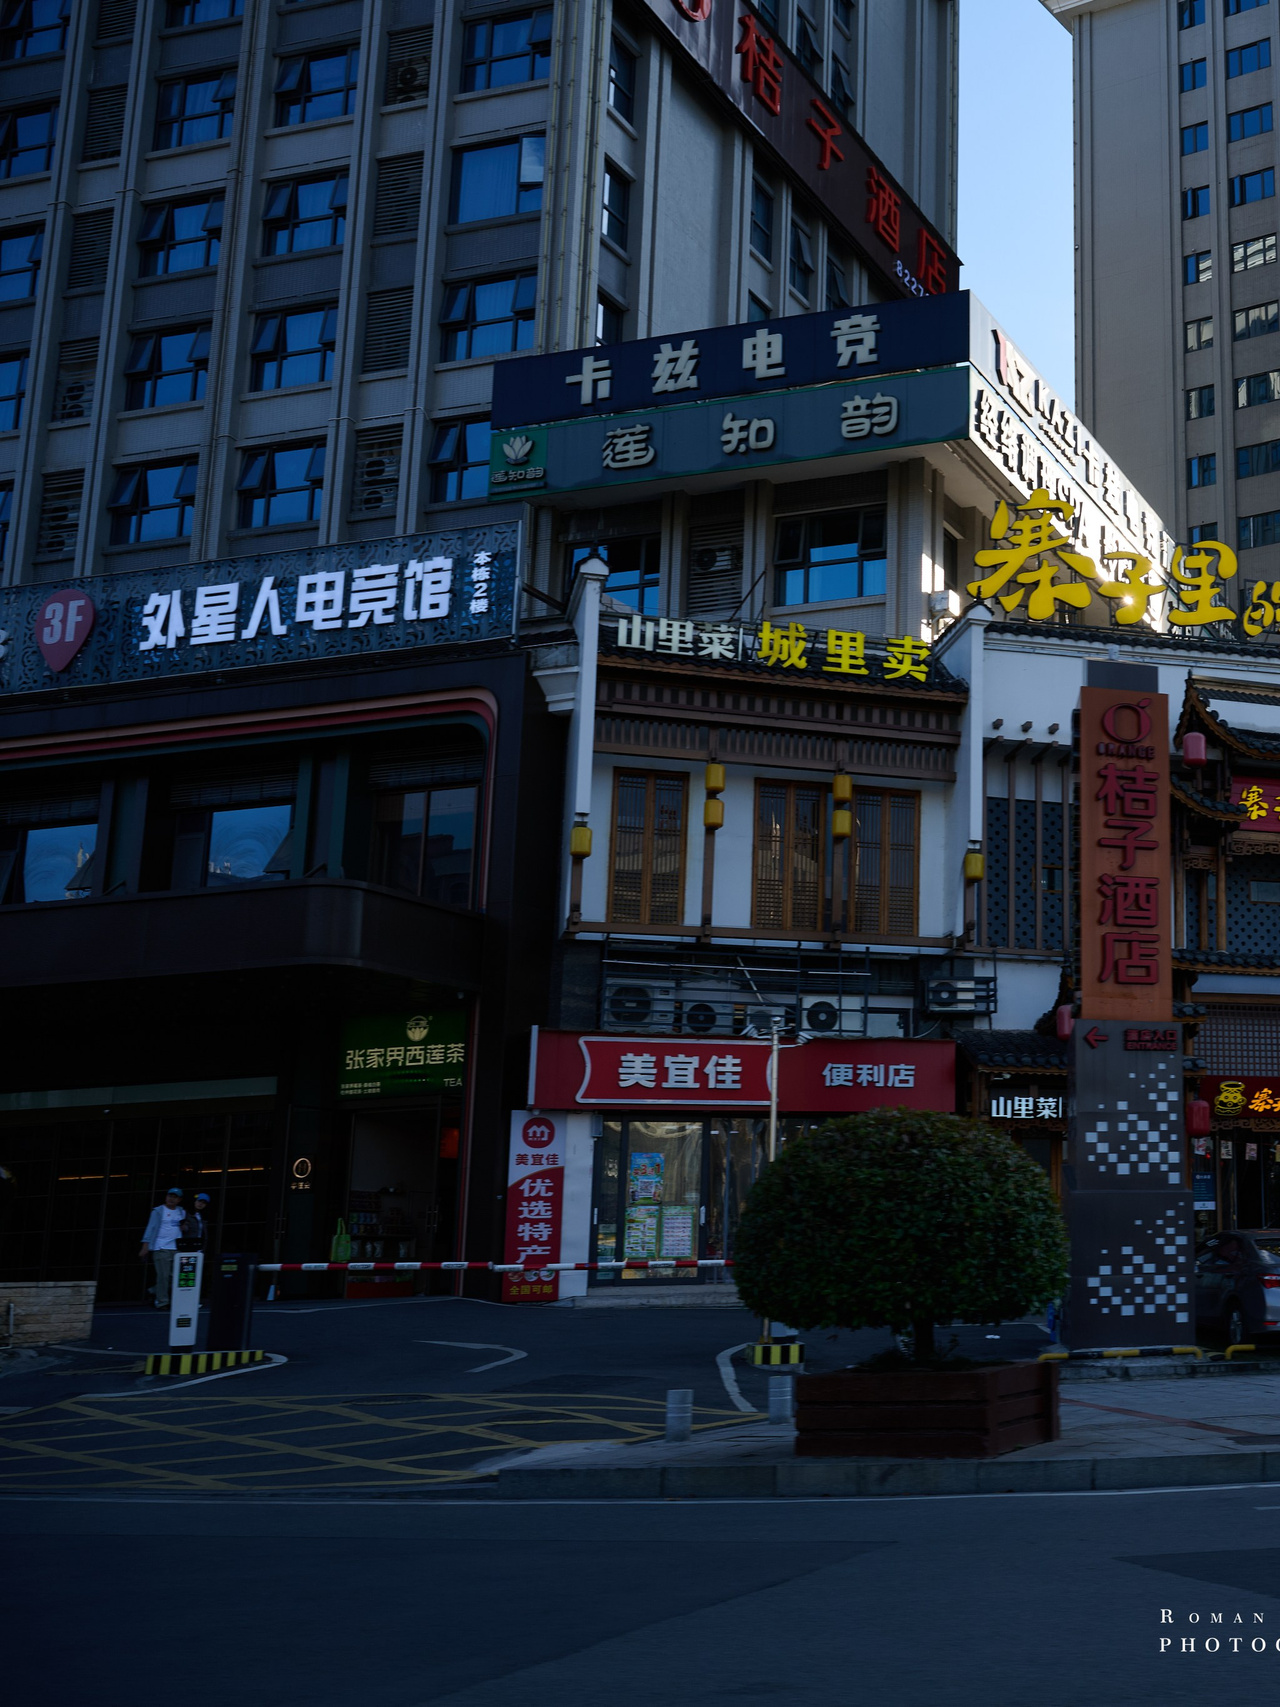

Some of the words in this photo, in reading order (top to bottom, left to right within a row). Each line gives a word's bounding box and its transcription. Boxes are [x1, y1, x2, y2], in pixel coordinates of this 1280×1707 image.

[735, 13, 948, 294] 桔子酒店
[896, 259, 930, 297] 8227
[565, 313, 881, 405] 卡兹电竞
[601, 391, 899, 470] 莲知韵
[469, 550, 492, 614] 本栋2楼
[42, 599, 86, 645] 3F
[138, 555, 454, 652] 外星人电竞馆
[617, 617, 737, 661] 山里菜
[757, 621, 932, 682] 城里卖
[1096, 742, 1156, 760] ORANGE
[1096, 762, 1161, 986] 桔子酒店
[1124, 1029, 1178, 1042] 酒店入口
[1124, 1042, 1178, 1052] ENTRANCE
[345, 1043, 466, 1070] 张家界西莲茶
[617, 1052, 743, 1090] 美宜佳
[821, 1061, 916, 1089] 便利店
[443, 1077, 463, 1088] TEA
[991, 1095, 1058, 1119] 山里菜
[515, 1153, 559, 1166] 美宜佳
[515, 1178, 554, 1264] 优选特产
[509, 1284, 553, 1296] 全国可邮
